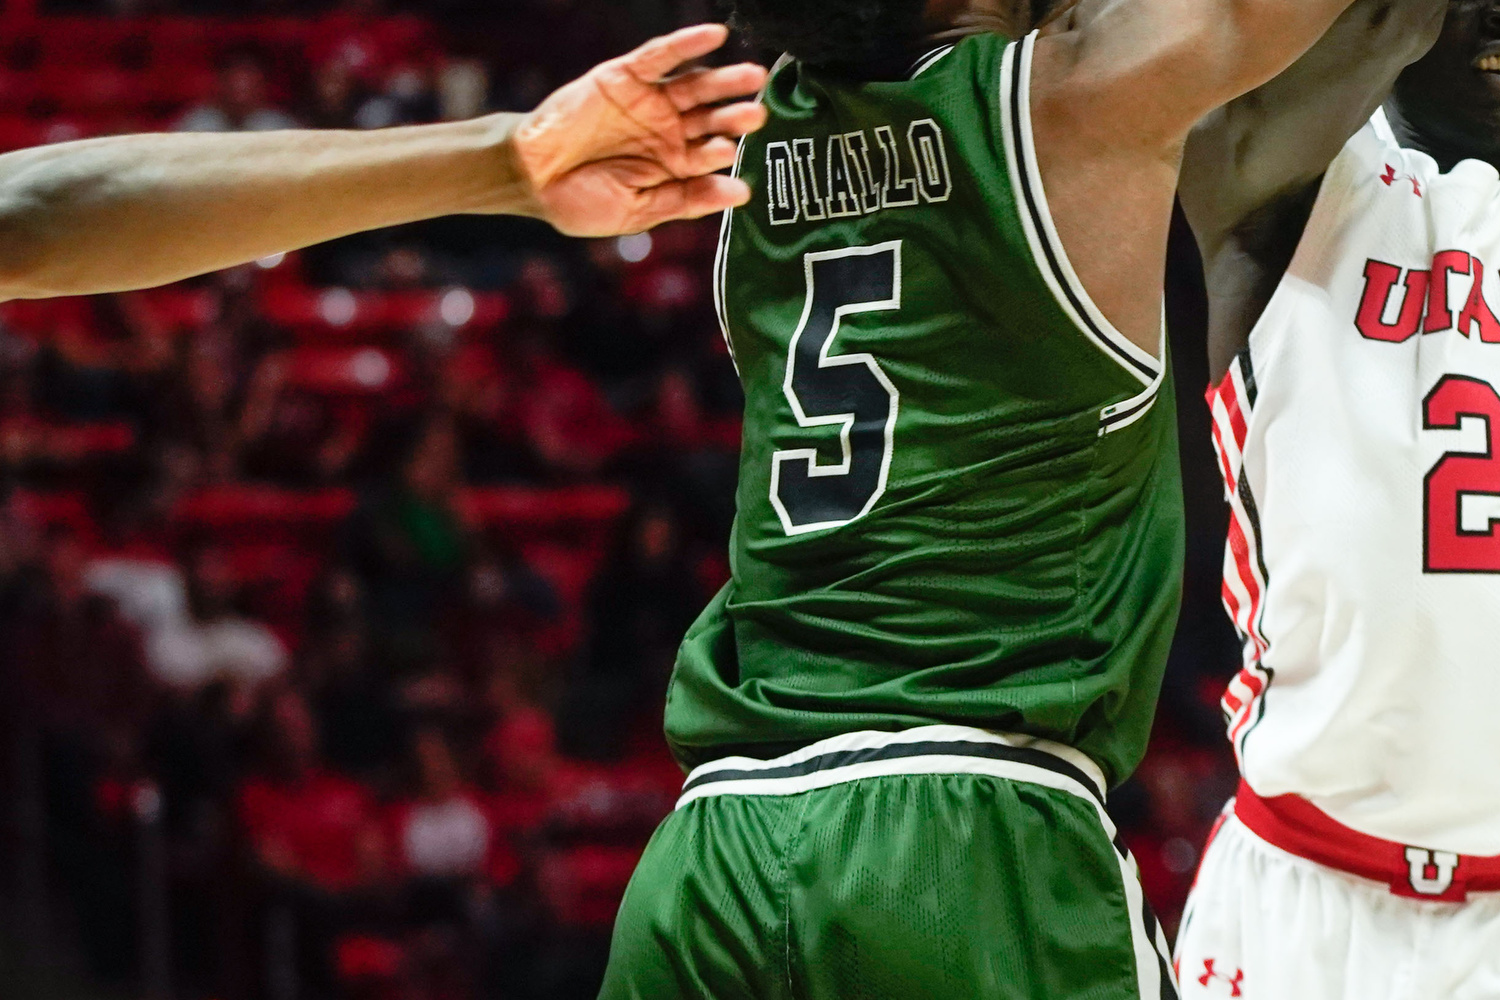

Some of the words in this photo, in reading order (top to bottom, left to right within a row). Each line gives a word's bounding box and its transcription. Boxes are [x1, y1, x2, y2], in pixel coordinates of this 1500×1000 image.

[765, 118, 952, 225] DIALLO
[769, 240, 902, 536] 5
[1404, 846, 1459, 894] U
